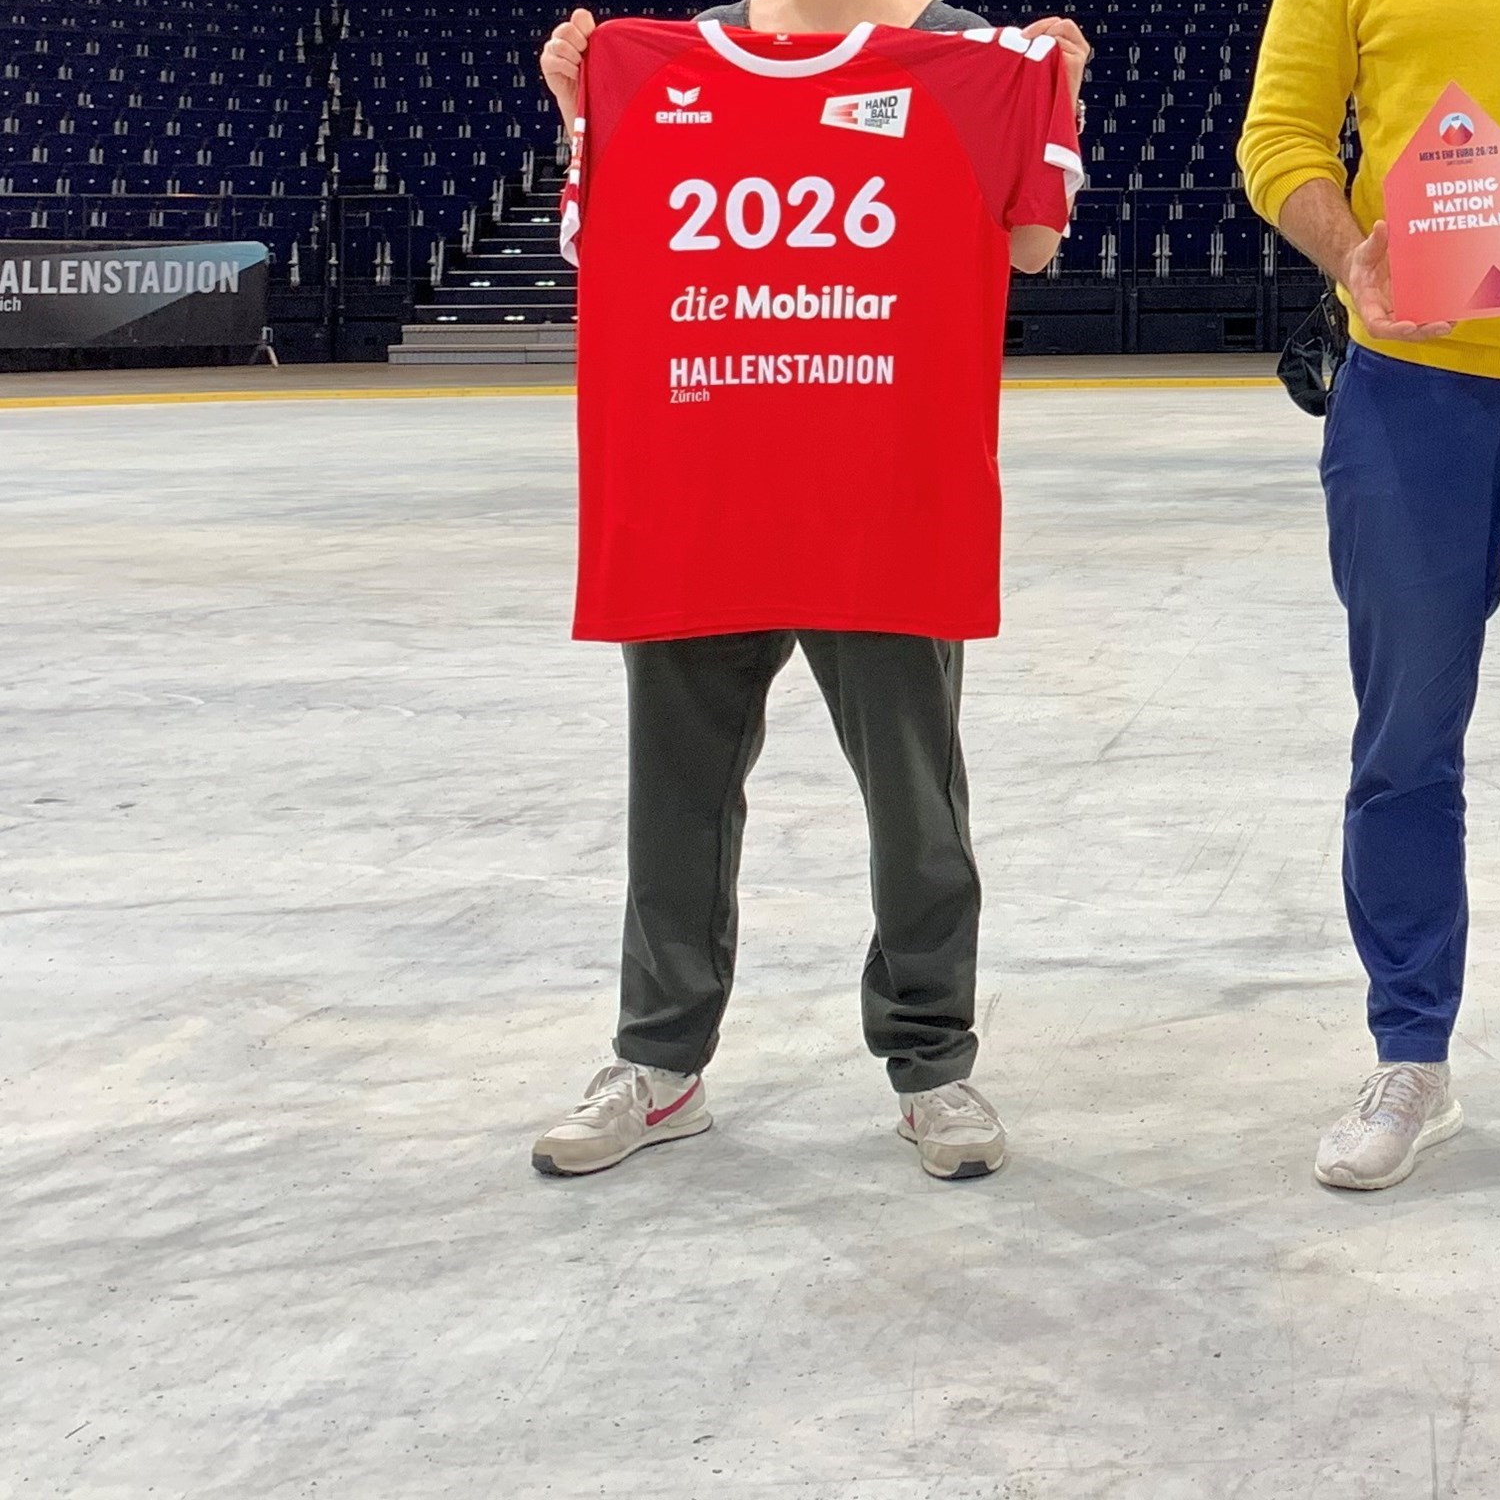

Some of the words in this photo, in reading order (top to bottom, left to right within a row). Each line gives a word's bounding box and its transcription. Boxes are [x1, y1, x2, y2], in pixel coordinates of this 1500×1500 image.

[865, 96, 898, 109] HAND
[655, 108, 713, 125] erima
[871, 108, 898, 118] BALL
[1425, 177, 1499, 198] BIDDING
[668, 175, 897, 251] 2026
[1432, 195, 1495, 214] NATION
[0, 260, 240, 295] ALLENSTADION
[670, 285, 728, 323] die
[734, 285, 898, 320] Mobiliar
[670, 354, 894, 388] HALLENSTADION
[670, 388, 711, 404] Zürich
